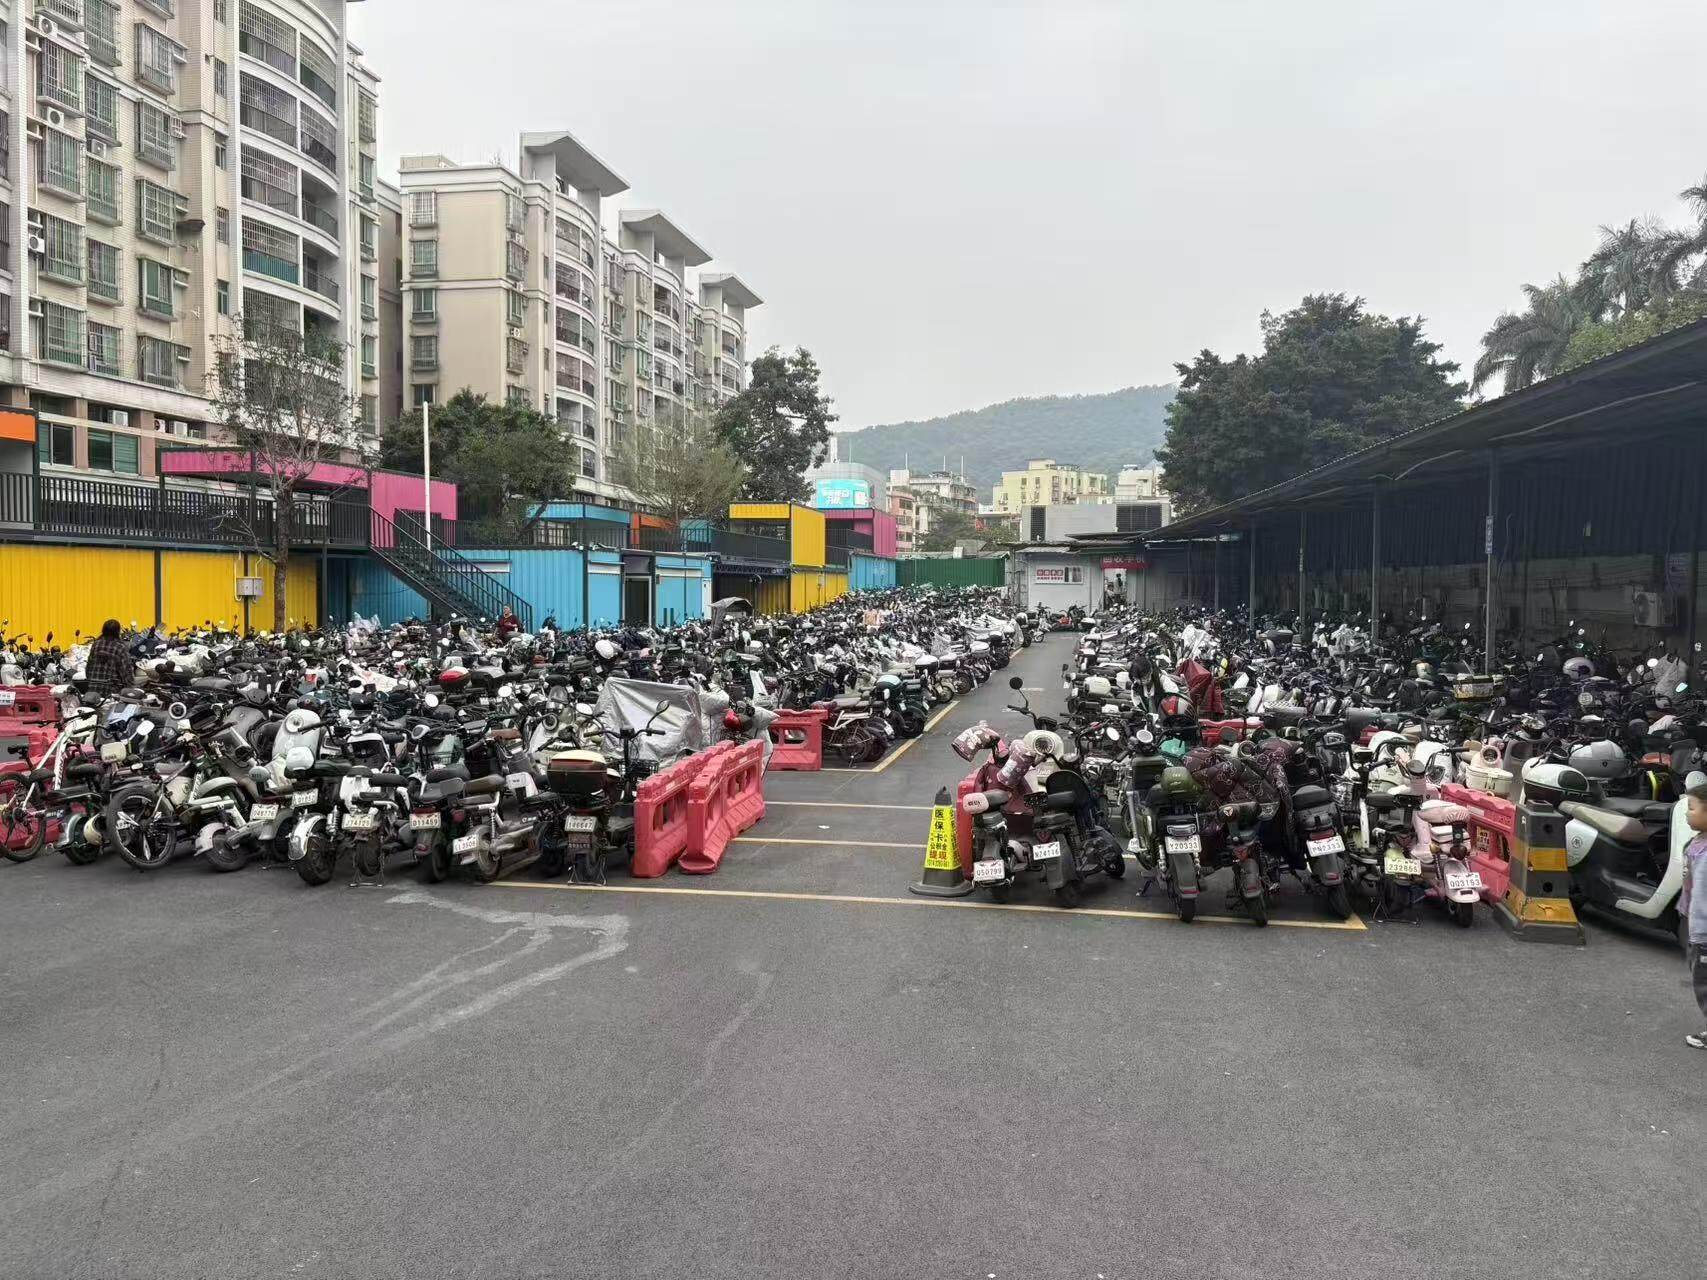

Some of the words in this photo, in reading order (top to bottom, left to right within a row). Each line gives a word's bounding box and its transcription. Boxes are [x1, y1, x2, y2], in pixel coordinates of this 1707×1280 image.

[934, 809, 944, 842] 医保卡
[929, 850, 948, 860] 提现
